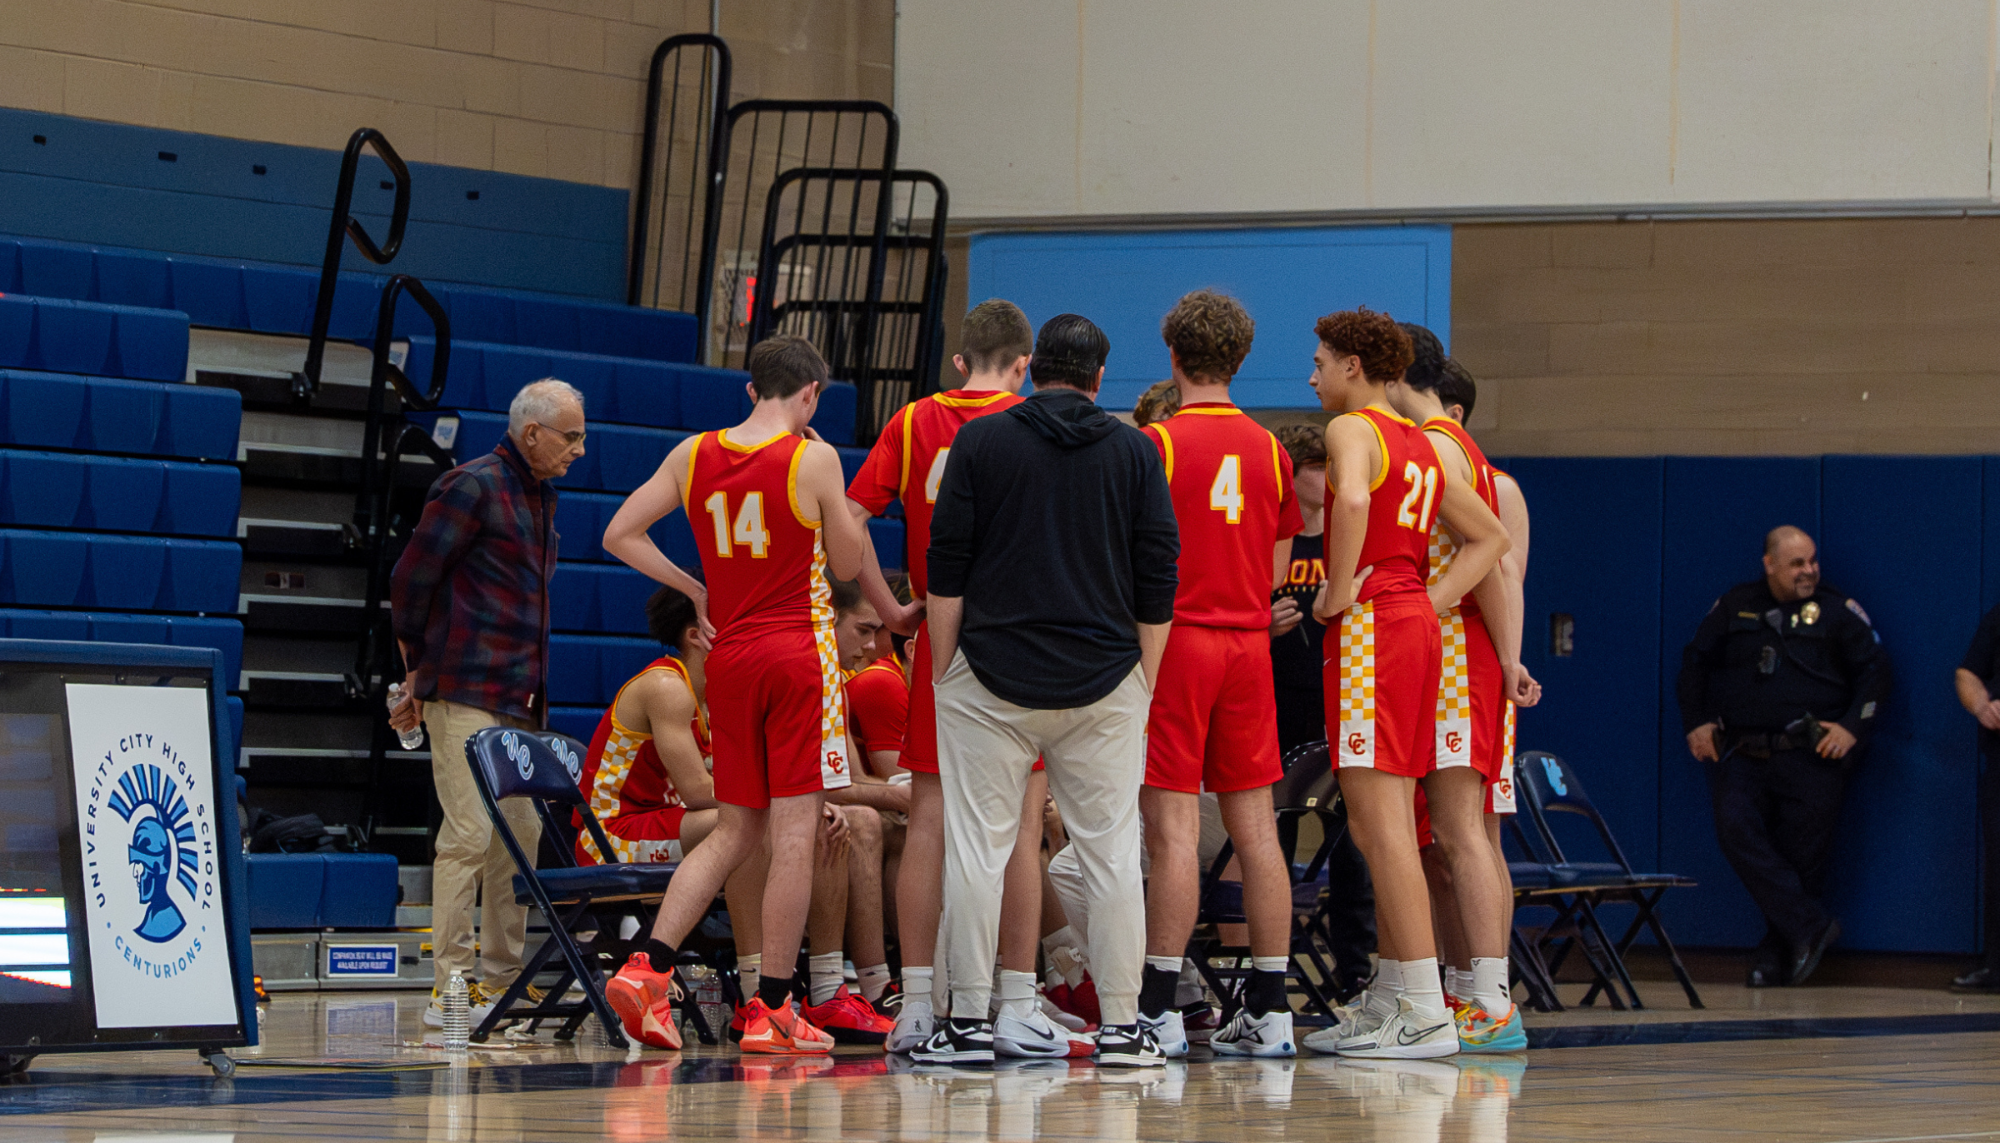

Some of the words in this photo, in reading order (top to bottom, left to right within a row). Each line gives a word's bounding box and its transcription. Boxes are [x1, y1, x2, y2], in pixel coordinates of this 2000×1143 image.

[1209, 454, 1244, 524] 4
[1397, 460, 1438, 533] 21
[704, 490, 771, 559] 14
[827, 750, 844, 775] CC
[1348, 732, 1366, 756] CC
[1445, 731, 1462, 753] CC
[86, 750, 115, 908] UNIVERSITY
[119, 733, 154, 753] CITY
[162, 742, 196, 791] HIGH
[196, 803, 213, 910] SCHOOL
[114, 935, 202, 979] CENTURIONS
